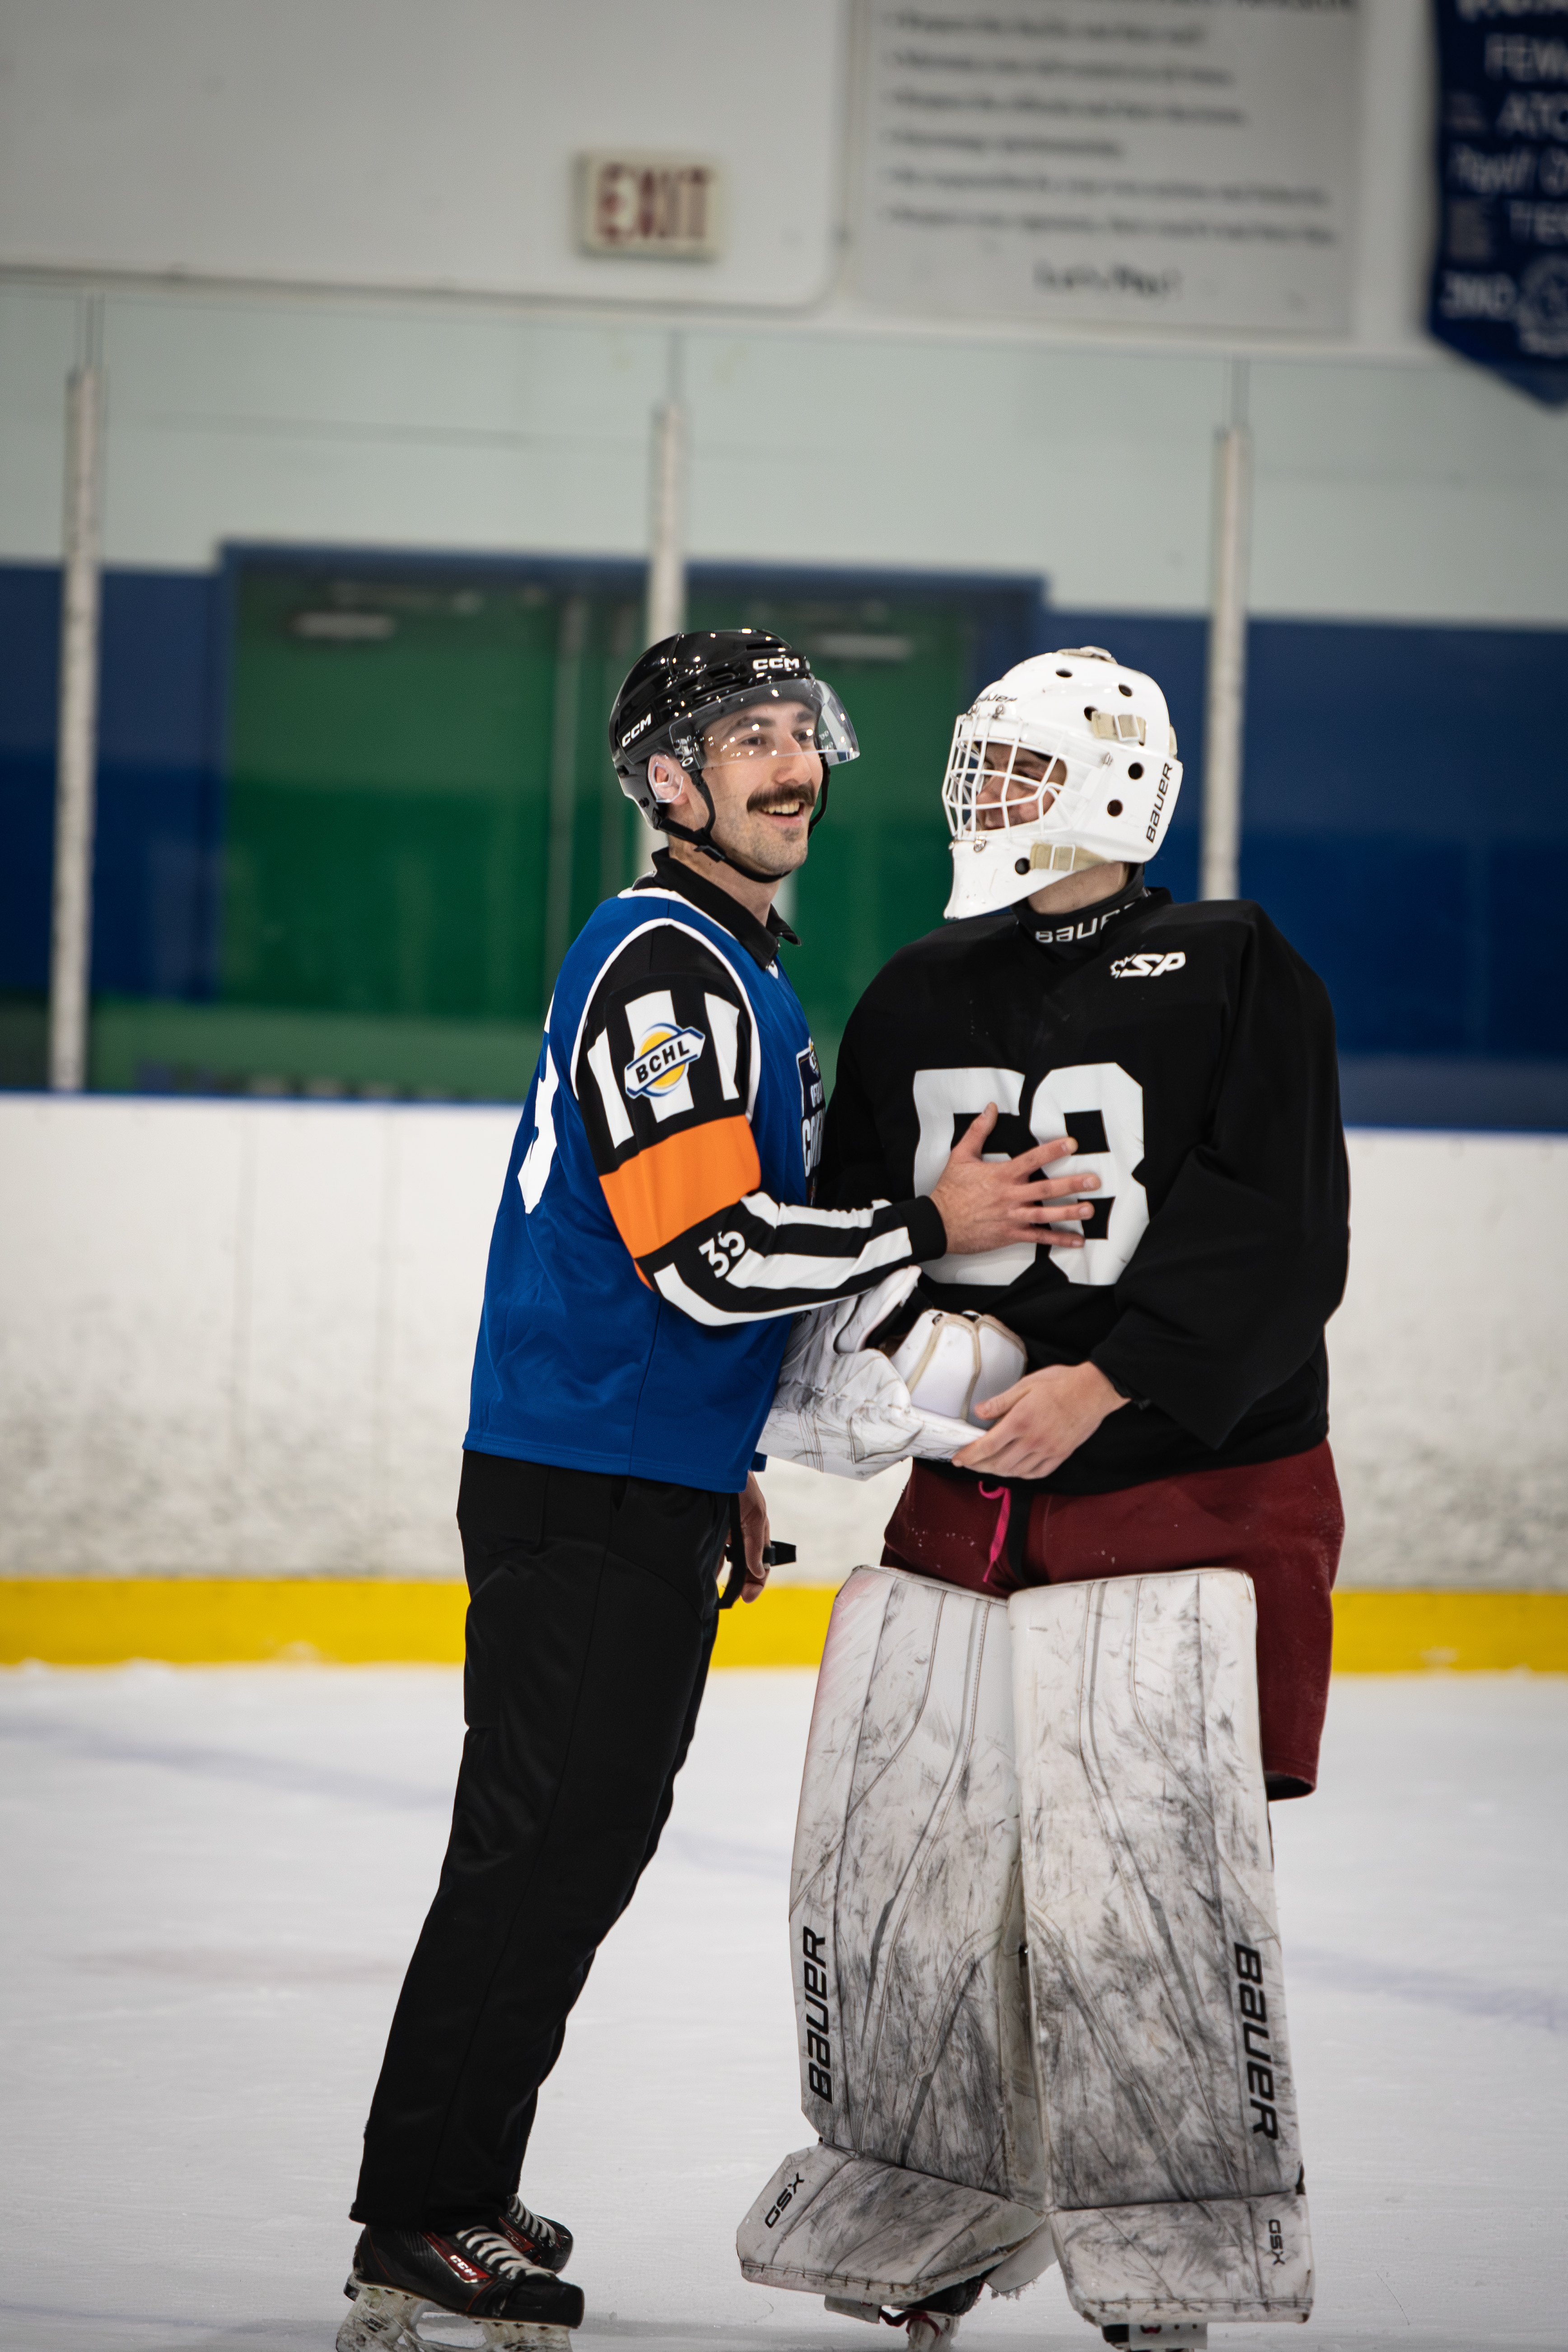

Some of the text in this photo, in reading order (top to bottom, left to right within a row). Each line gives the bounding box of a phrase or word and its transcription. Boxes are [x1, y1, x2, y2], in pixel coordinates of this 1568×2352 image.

[597, 163, 710, 245] EXIT
[752, 658, 800, 671] CCM
[622, 713, 651, 747] CCM
[1146, 762, 1173, 844] BAUER
[1035, 902, 1135, 944] BAU
[635, 1041, 690, 1084] BCHL
[803, 1926, 832, 2104] BAUER
[1234, 1941, 1279, 2141] BAUER
[765, 2172, 805, 2229] GSX
[1269, 2219, 1285, 2265] GSX
